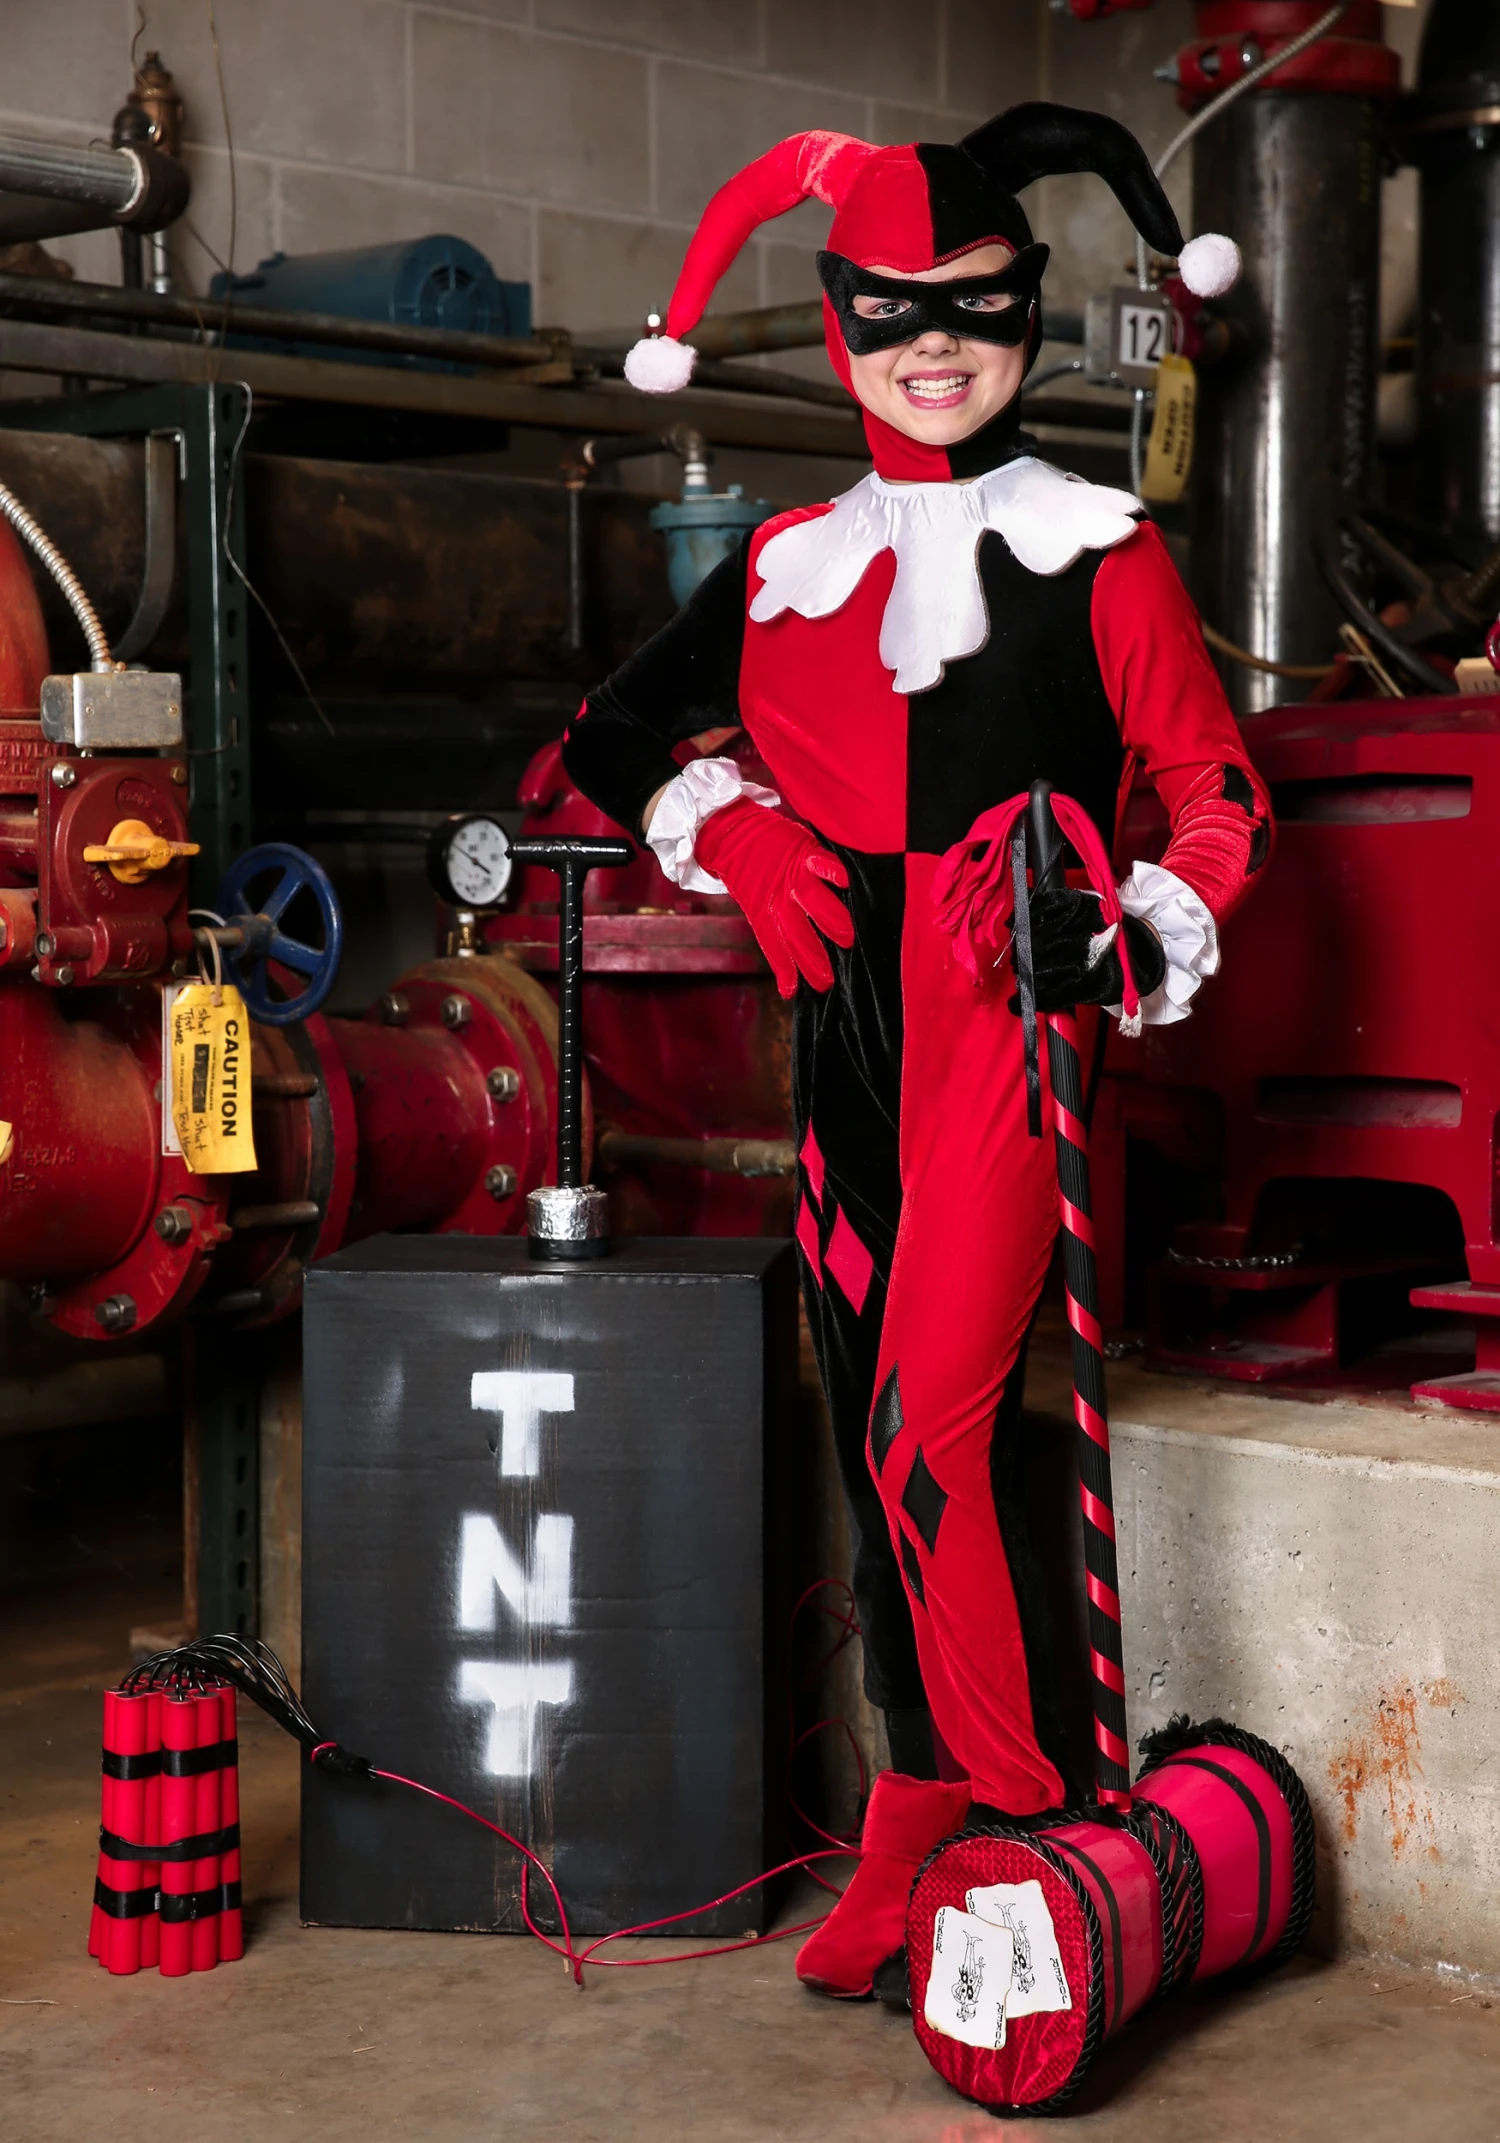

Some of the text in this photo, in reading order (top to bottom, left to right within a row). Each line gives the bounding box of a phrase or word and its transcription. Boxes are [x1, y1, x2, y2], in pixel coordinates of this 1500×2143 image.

[1128, 316, 1161, 362] 12
[221, 1020, 239, 1136] CAUTION
[460, 1371, 576, 1776] TNT
[936, 1908, 946, 1953] JOKER
[1050, 1957, 1067, 2004] JOKER
[994, 2002, 1004, 2048] JOKER
